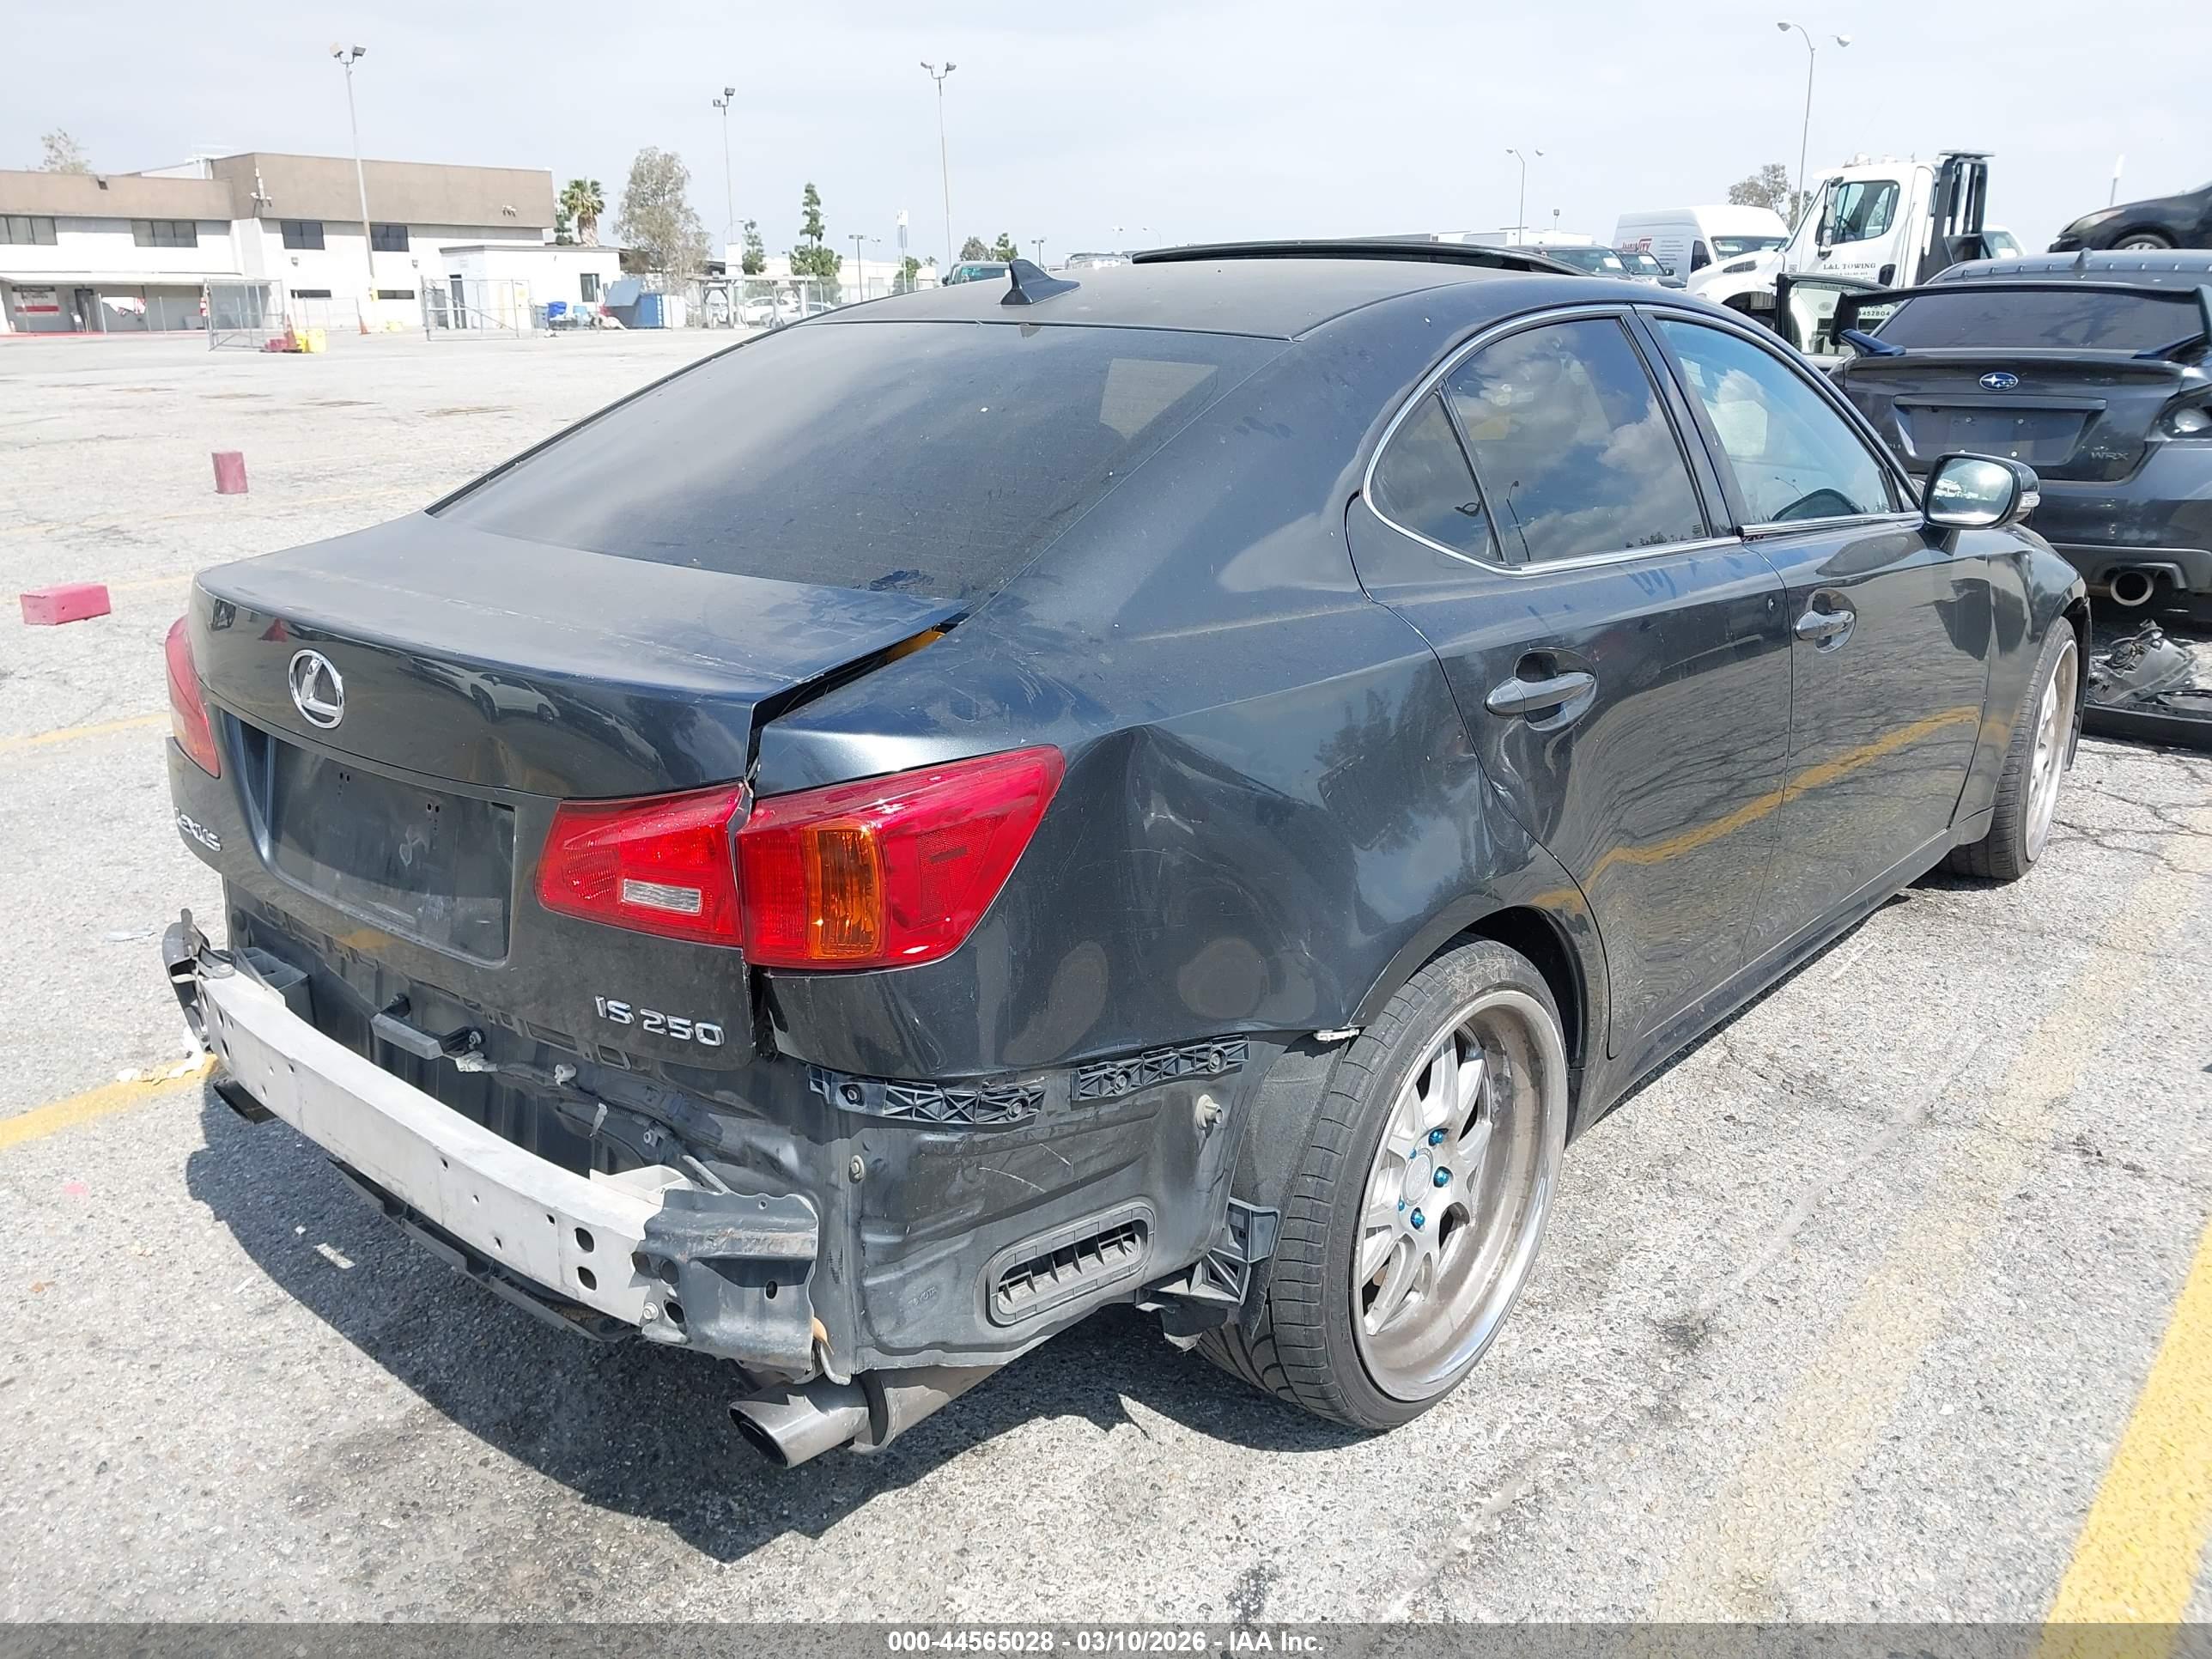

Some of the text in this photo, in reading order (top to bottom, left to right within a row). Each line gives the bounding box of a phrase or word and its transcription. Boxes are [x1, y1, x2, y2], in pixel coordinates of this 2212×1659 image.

[2090, 452, 2130, 461] WRX
[595, 995, 725, 1047] IS 250
